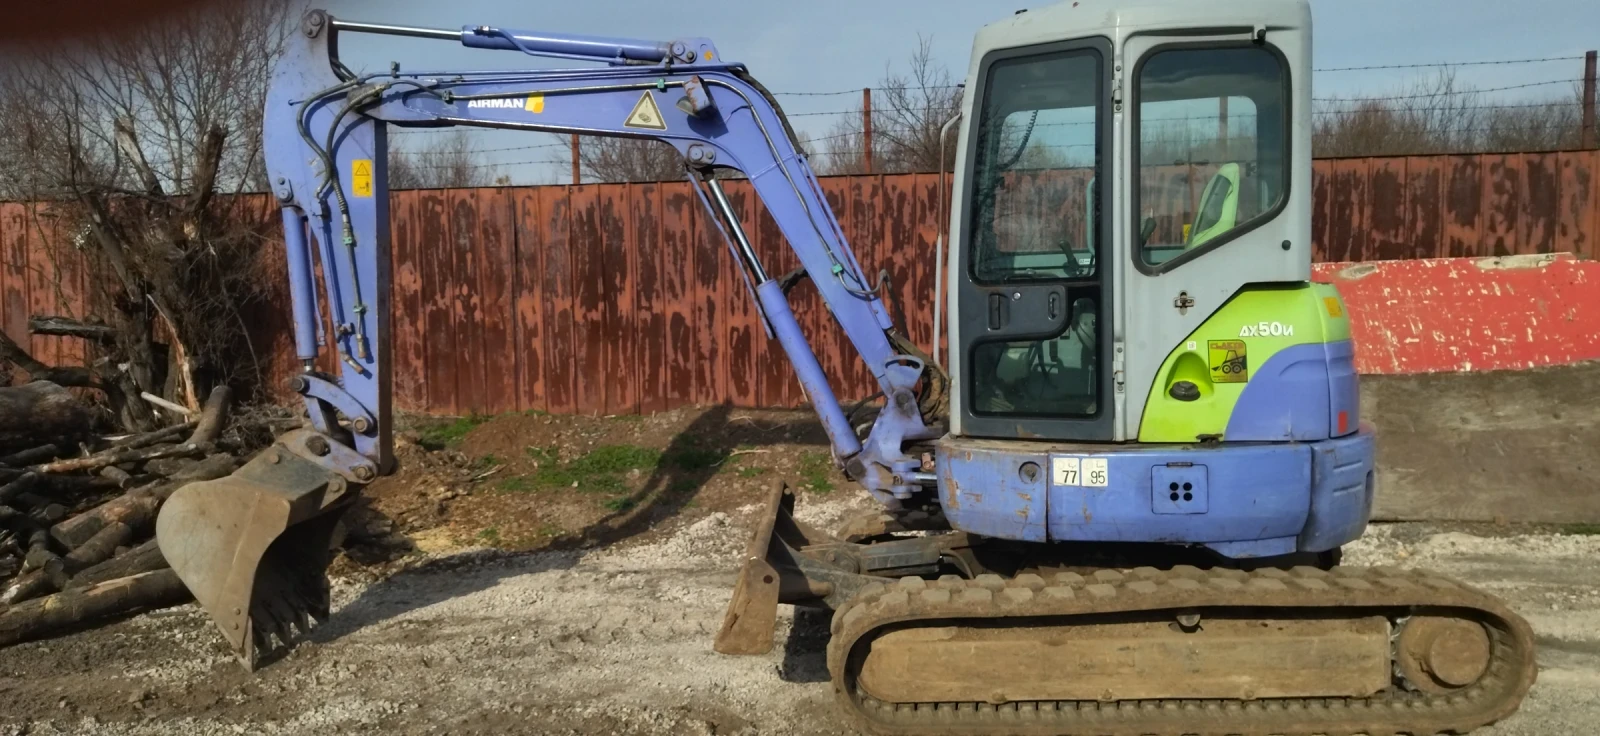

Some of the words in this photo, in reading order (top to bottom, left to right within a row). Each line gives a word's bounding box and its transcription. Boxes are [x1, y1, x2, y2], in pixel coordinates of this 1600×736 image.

[467, 98, 524, 108] AIRMAN
[1062, 470, 1077, 484] 77
[1090, 470, 1106, 485] 95
